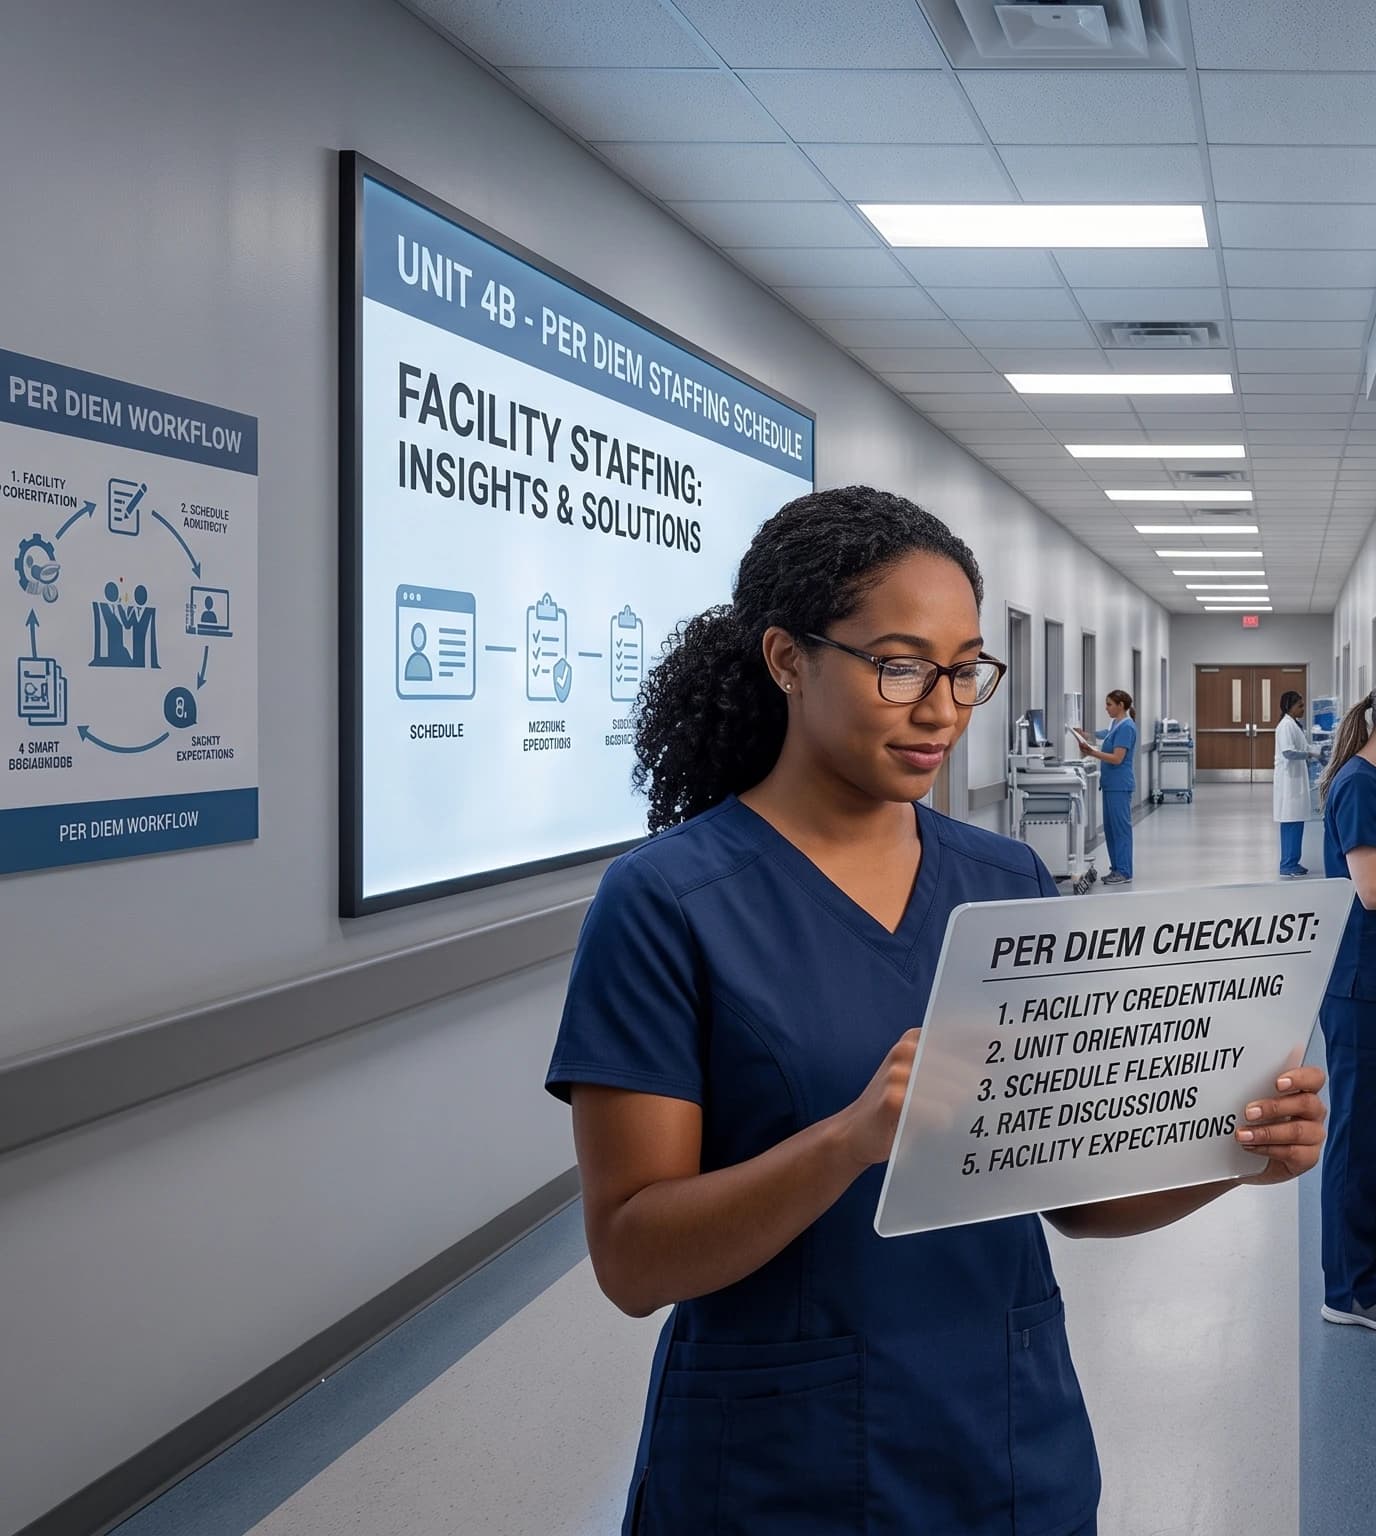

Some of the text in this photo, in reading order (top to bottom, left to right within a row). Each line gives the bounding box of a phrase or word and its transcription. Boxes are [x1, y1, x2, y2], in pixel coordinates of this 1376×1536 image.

[397, 234, 803, 461] UNIT 4B - PER DIEM STAFFING SCHEDULE
[9, 376, 242, 454] PER DIEM WORKFLOW
[399, 361, 702, 507] FACILITY STAFFING:
[11, 470, 66, 490] 1. FACILITY
[399, 440, 701, 554] INSIGHTS & SOLUTIONS
[190, 504, 229, 520] SCHEDULE
[28, 741, 59, 754] SMART
[176, 748, 234, 761] EXPECTATIONS
[409, 723, 464, 740] SCHEDULE
[59, 811, 199, 842] PER DIEM WORKFLOW
[990, 911, 1320, 970] PER DIEM CHECKLIST:
[998, 974, 1284, 1026] 1. FACILITY CREDENTIALING
[985, 1016, 1211, 1065] 2. UNIT ORIENTATION
[977, 1046, 1245, 1102] 3. SCHEDULE FLEXIBILITY
[969, 1086, 1199, 1139] 4. RATE DISCUSSIONS
[961, 1113, 1237, 1176] 5. FACILITY EXPECTATIONS
